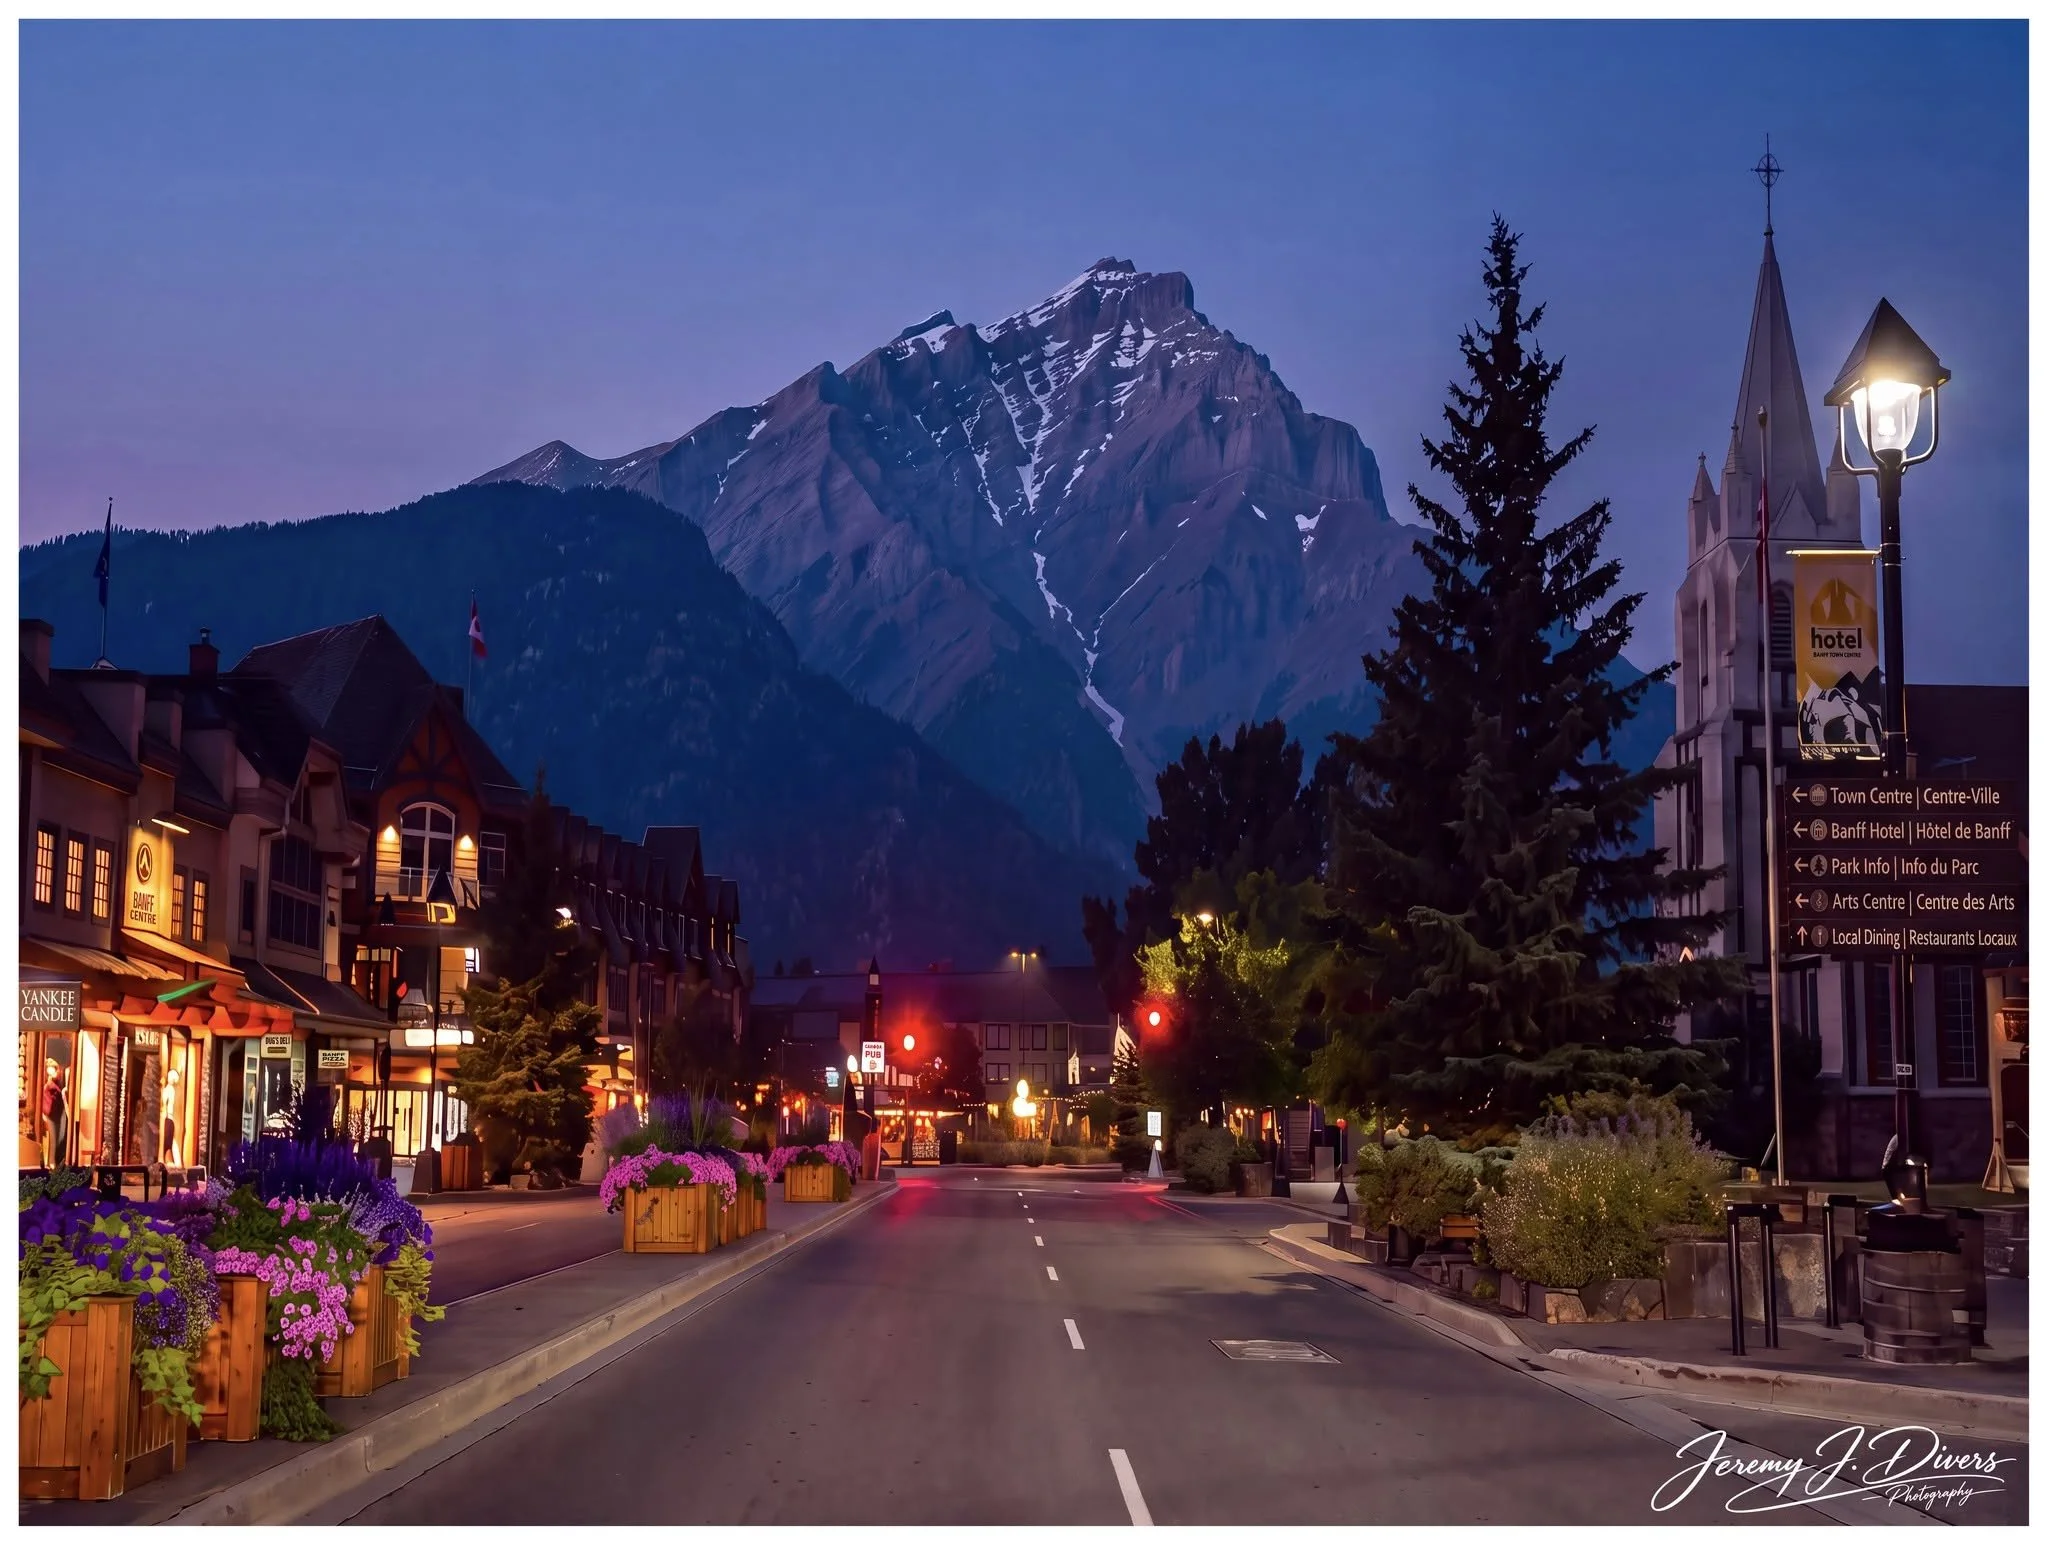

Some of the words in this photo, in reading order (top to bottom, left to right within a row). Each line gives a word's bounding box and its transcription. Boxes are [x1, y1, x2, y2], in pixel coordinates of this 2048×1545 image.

[1811, 627, 1862, 649] hotel
[1830, 787, 1866, 804] Town
[1870, 787, 1913, 804] Centre
[1923, 786, 2000, 804] Centre-Ville
[1831, 821, 1867, 839] Banff
[1870, 821, 1905, 839] Hotel
[1955, 821, 1971, 839] de
[1975, 821, 2011, 839] Banff
[1832, 857, 1860, 874] Park
[1864, 857, 1890, 874] Info
[1901, 857, 1927, 874] Info
[1930, 857, 1947, 875] du
[1952, 858, 1979, 875] Parc
[1832, 893, 1859, 909] Arts
[1862, 893, 1906, 910] Centre
[1916, 893, 1959, 910] Centre
[1962, 892, 1985, 910] des
[1988, 893, 2015, 910] Arts
[130, 909, 157, 925] CENTRE
[1832, 927, 1861, 945] Local
[1864, 928, 1901, 950] Dining
[1909, 929, 1975, 946] Restaurants
[1978, 929, 2018, 946] Locaux
[21, 989, 75, 1006] YANKEE
[21, 1006, 75, 1022] CANDLE
[865, 1050, 881, 1058] PUB
